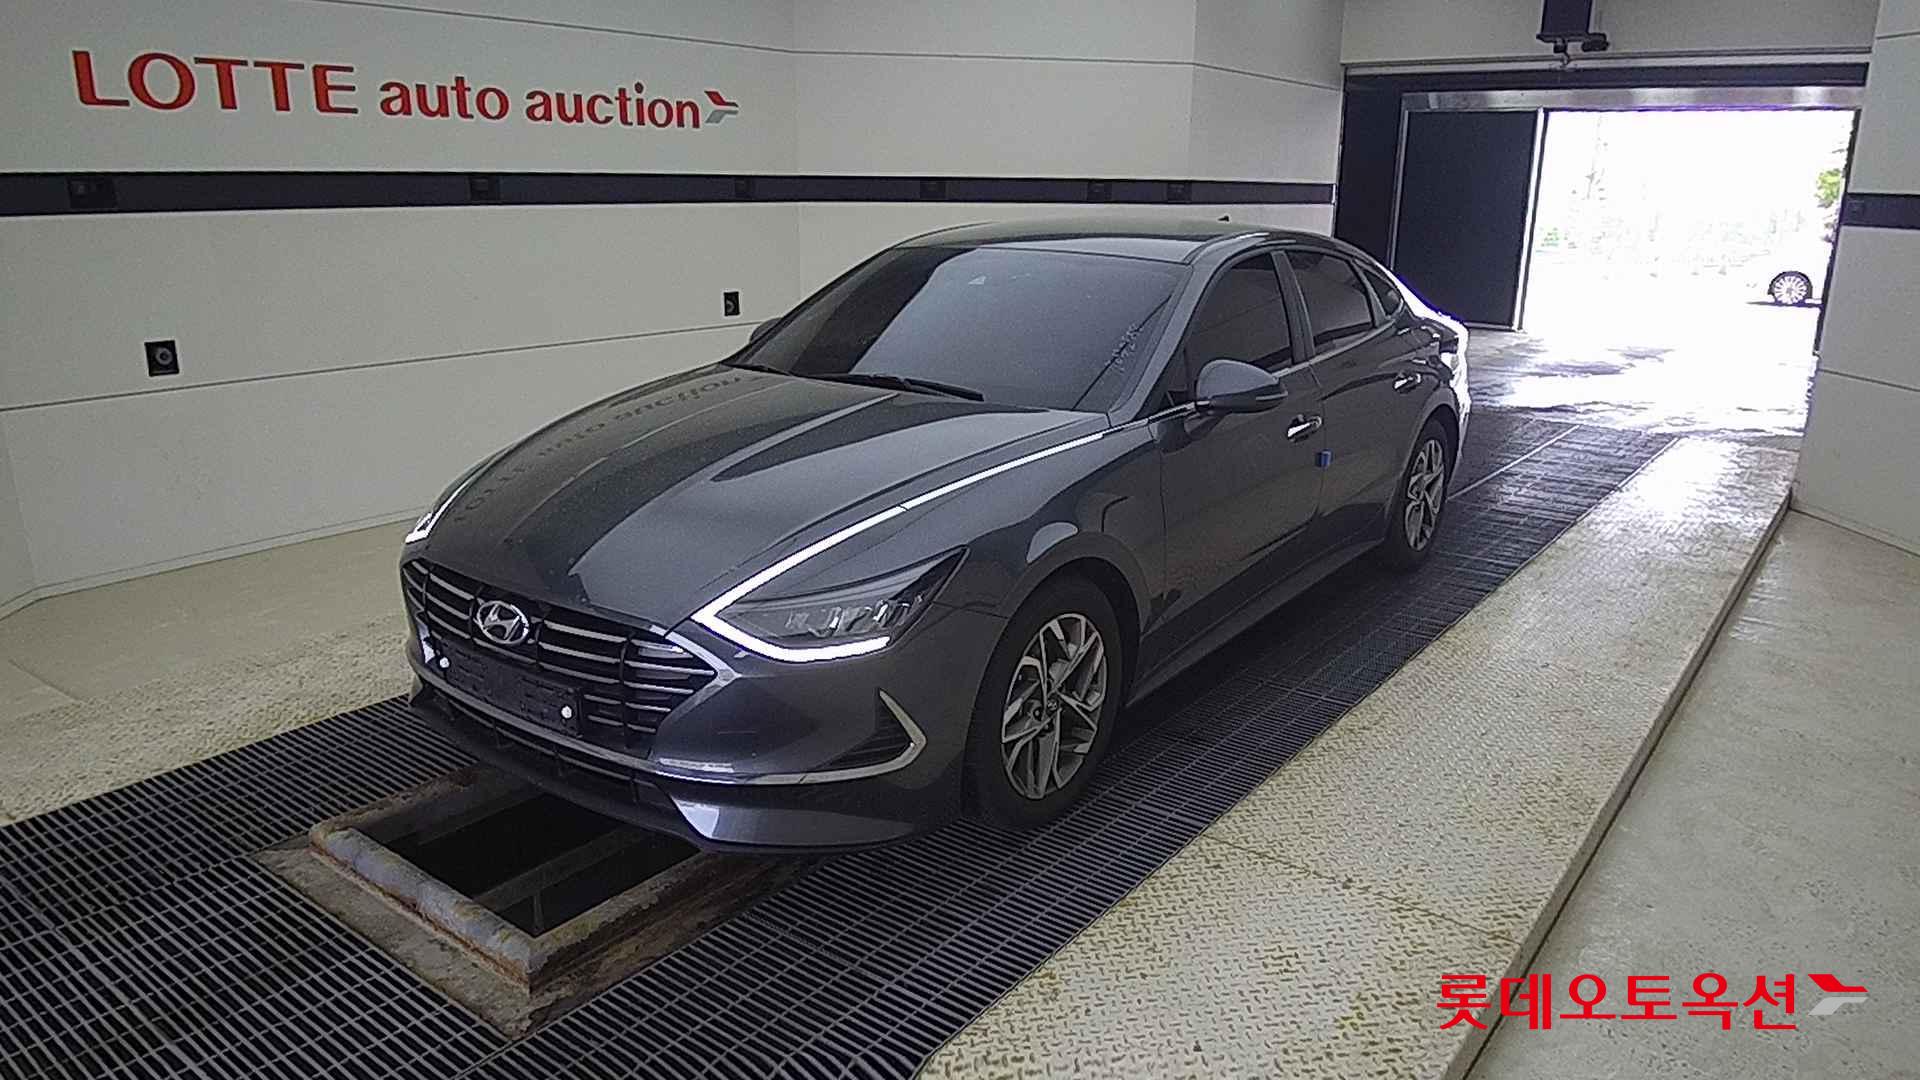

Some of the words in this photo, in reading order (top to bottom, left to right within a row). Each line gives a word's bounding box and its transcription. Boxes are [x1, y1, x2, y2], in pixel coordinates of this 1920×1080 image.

[72, 50, 359, 115] LOTTE
[380, 76, 511, 121] auto
[526, 82, 701, 129] auction
